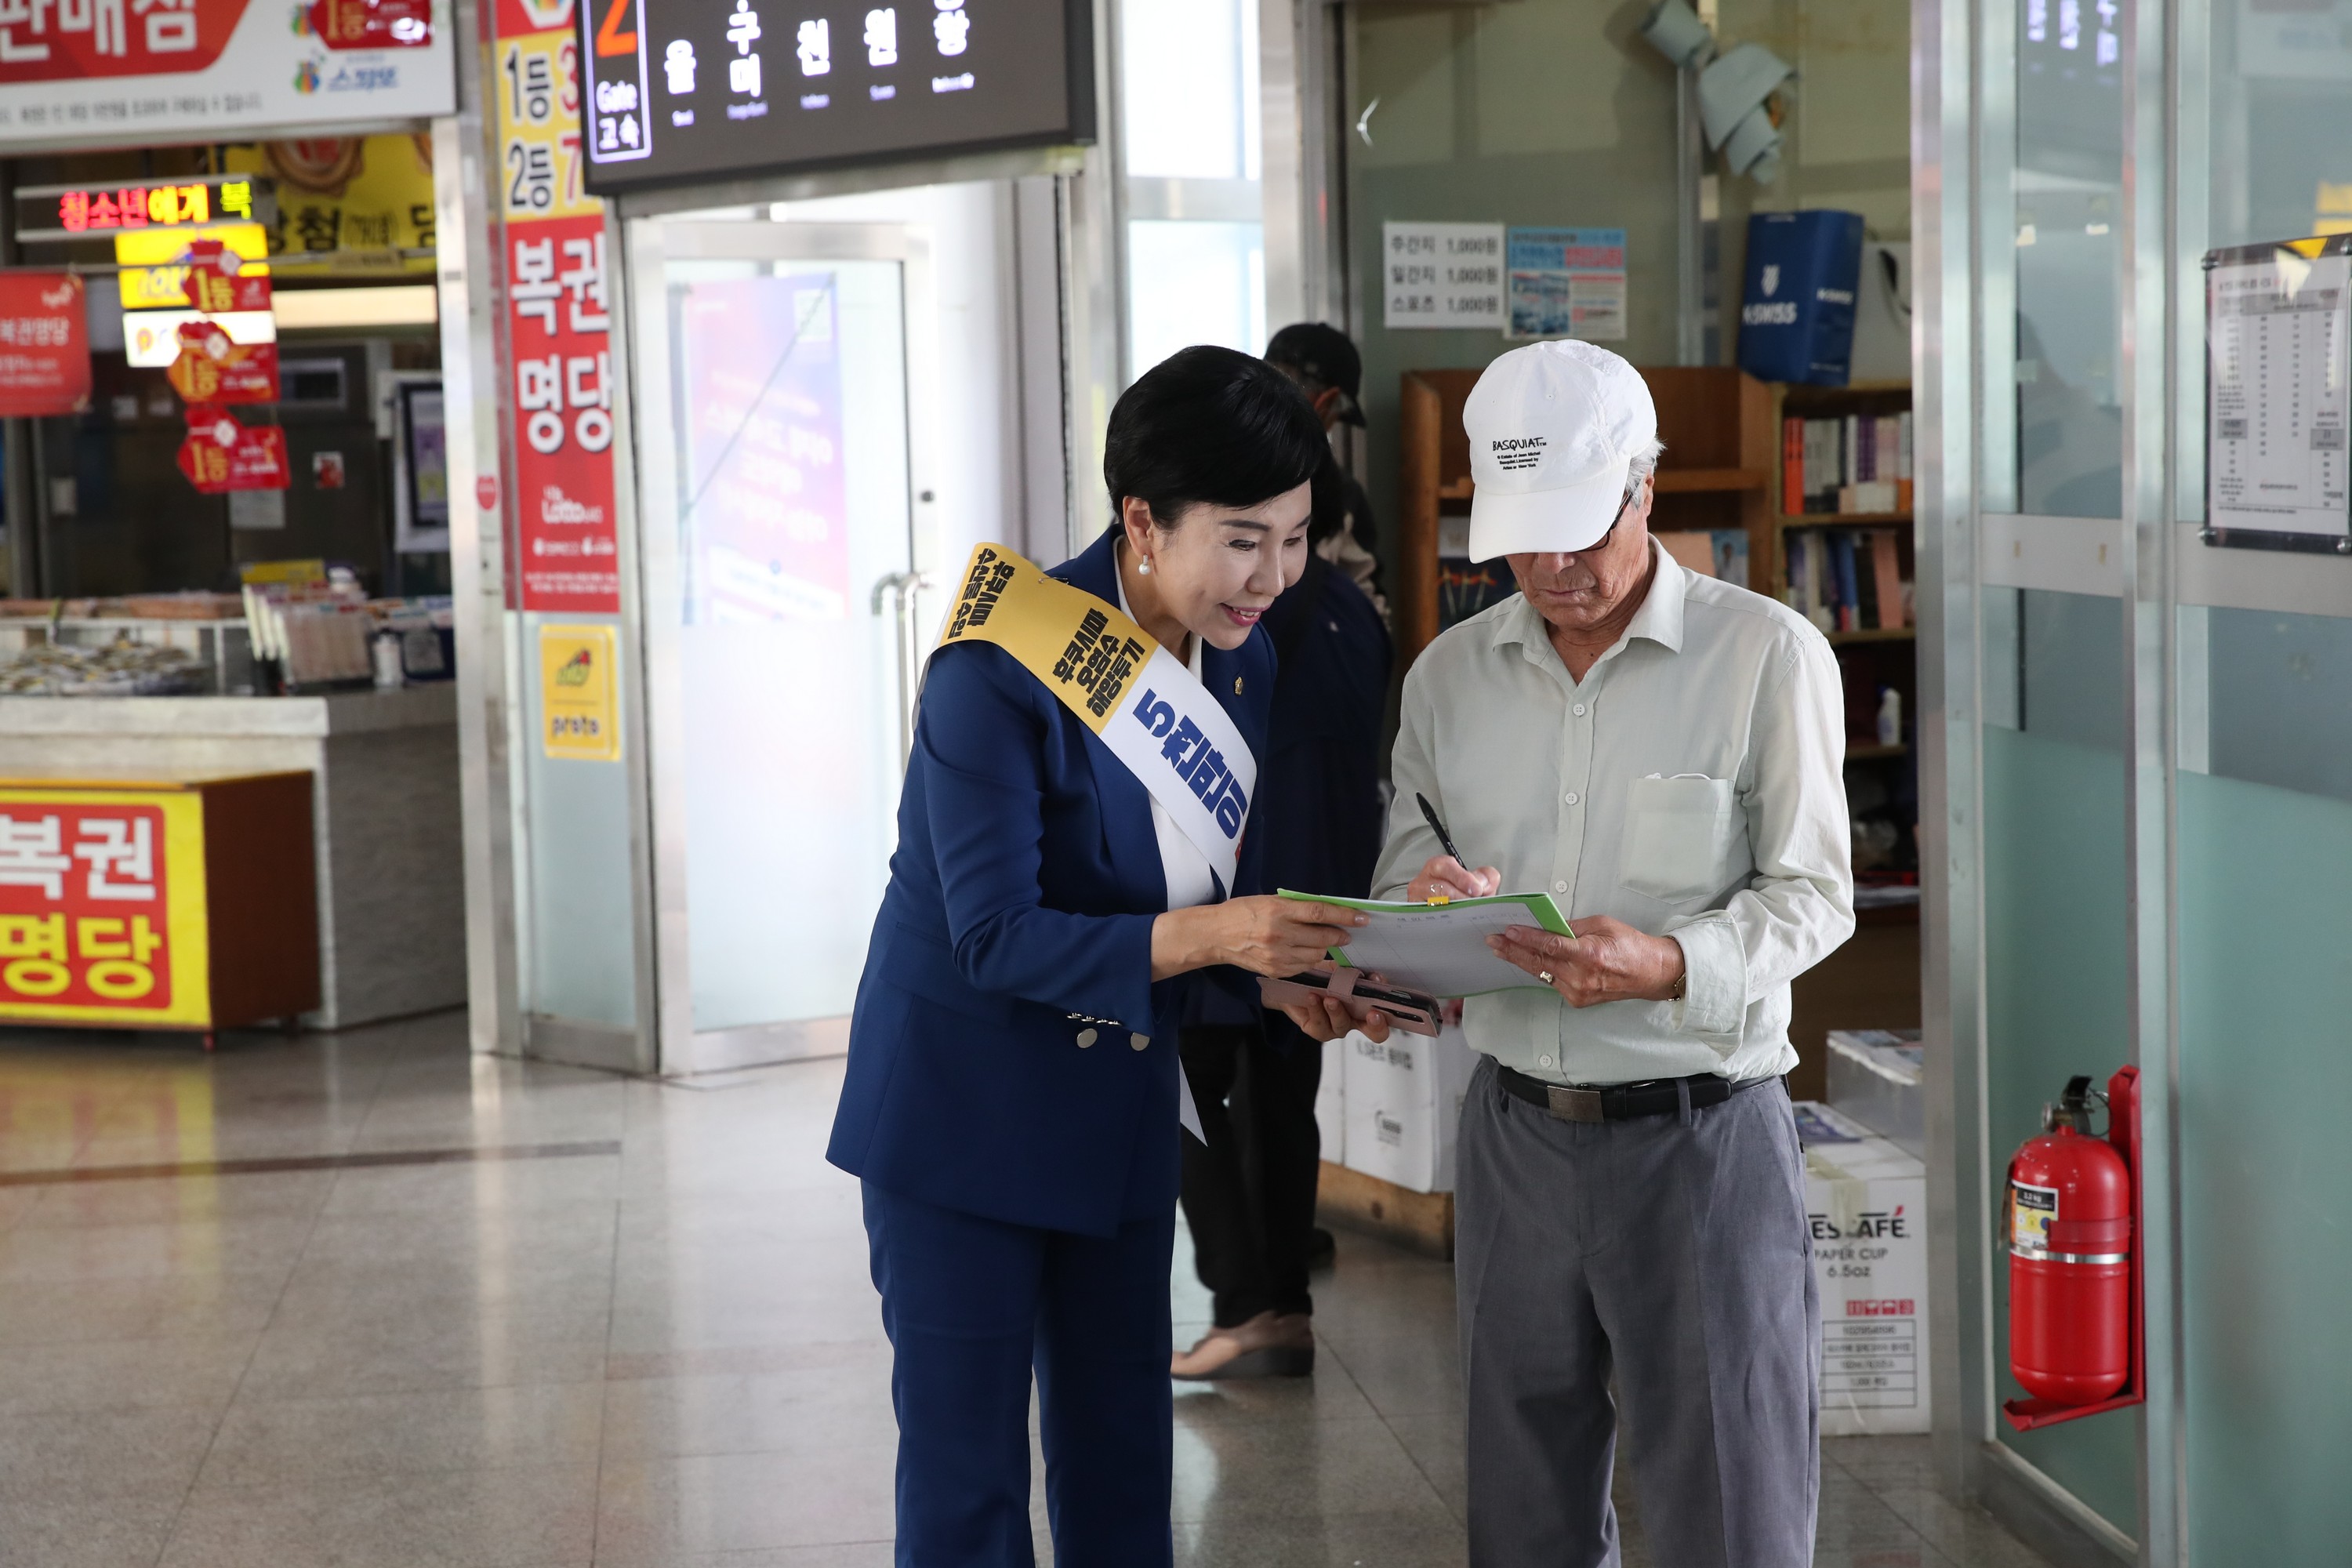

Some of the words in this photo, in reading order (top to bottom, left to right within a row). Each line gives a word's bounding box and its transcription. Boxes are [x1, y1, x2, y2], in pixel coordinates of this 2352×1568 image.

[60, 183, 209, 232] 청소년에게
[510, 143, 551, 207] 2등
[510, 233, 609, 336] 복권
[517, 351, 614, 454] 명당
[1493, 437, 1543, 451] BASQUIAT
[962, 548, 997, 598] 수산물
[967, 560, 1015, 626] 후쿠시마
[947, 602, 972, 639] 수입
[1053, 608, 1109, 684] 후쿠시마
[1076, 633, 1120, 694] 오염수
[1085, 637, 1146, 718] 해양투기
[0, 815, 155, 901] 복권
[0, 912, 161, 999] 명당
[1858, 1247, 1889, 1260] CUP
